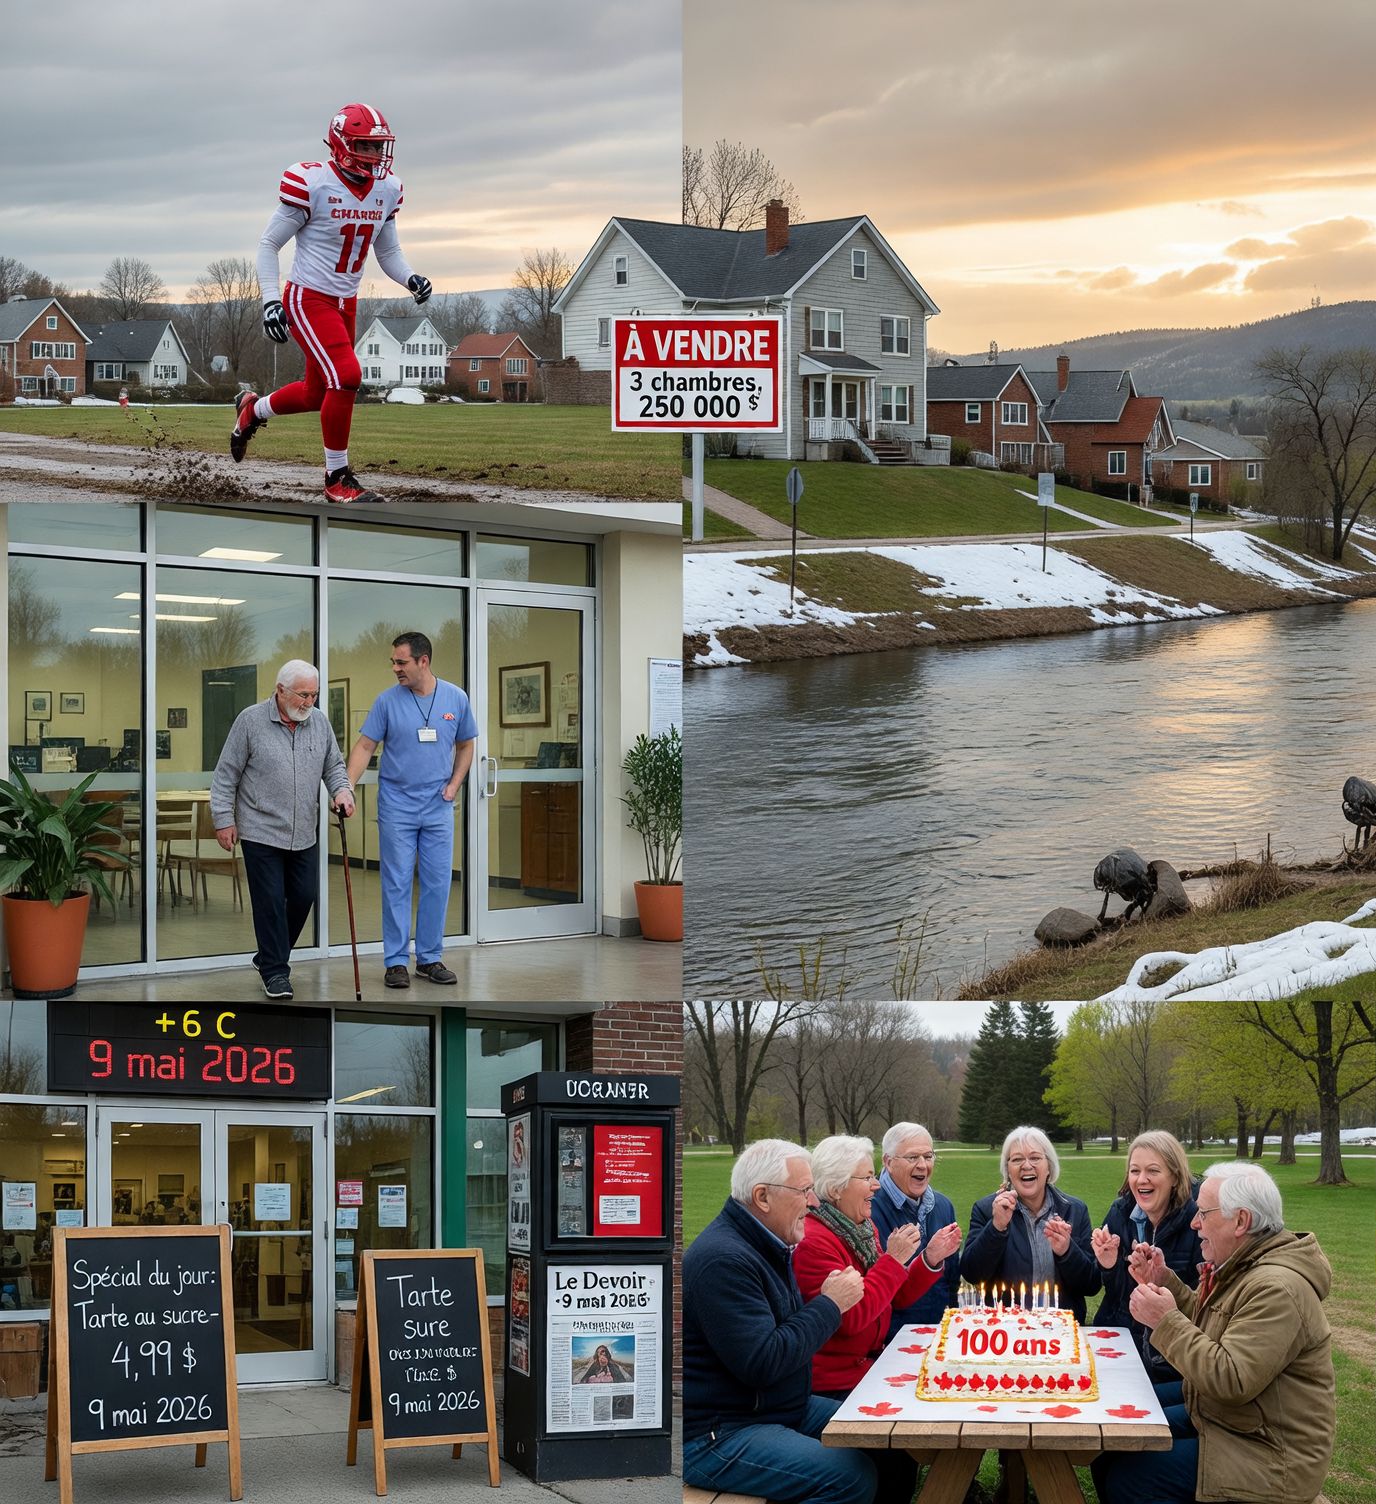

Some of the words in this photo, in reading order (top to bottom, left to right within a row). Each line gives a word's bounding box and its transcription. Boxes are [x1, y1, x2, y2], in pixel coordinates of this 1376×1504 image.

[623, 324, 645, 361] À
[653, 330, 770, 361] VENDRE
[630, 371, 643, 391] 3
[639, 395, 684, 418] 250
[694, 395, 740, 418] 000
[155, 1010, 202, 1038] +6
[216, 1011, 236, 1039] C
[89, 1040, 112, 1078] 9
[127, 1047, 184, 1080] mai
[202, 1045, 295, 1085] 2026
[73, 1259, 141, 1296] Spécial
[148, 1259, 170, 1286] du
[173, 1265, 216, 1296] jour:
[386, 1274, 454, 1308] Tarte
[555, 1272, 578, 1290] Le
[583, 1271, 646, 1289] Devoir
[74, 1300, 129, 1329] Tarte
[135, 1312, 155, 1326] au
[404, 1319, 451, 1339] sure
[957, 1328, 1008, 1355] 100
[1013, 1339, 1061, 1355] ans
[112, 1341, 171, 1382] 4,99
[182, 1342, 197, 1373] $
[88, 1399, 104, 1430] 9
[112, 1401, 147, 1426] mai
[156, 1394, 212, 1423] 2026
[388, 1392, 400, 1416] 9
[405, 1393, 431, 1414] mai
[437, 1390, 480, 1411] 2026
